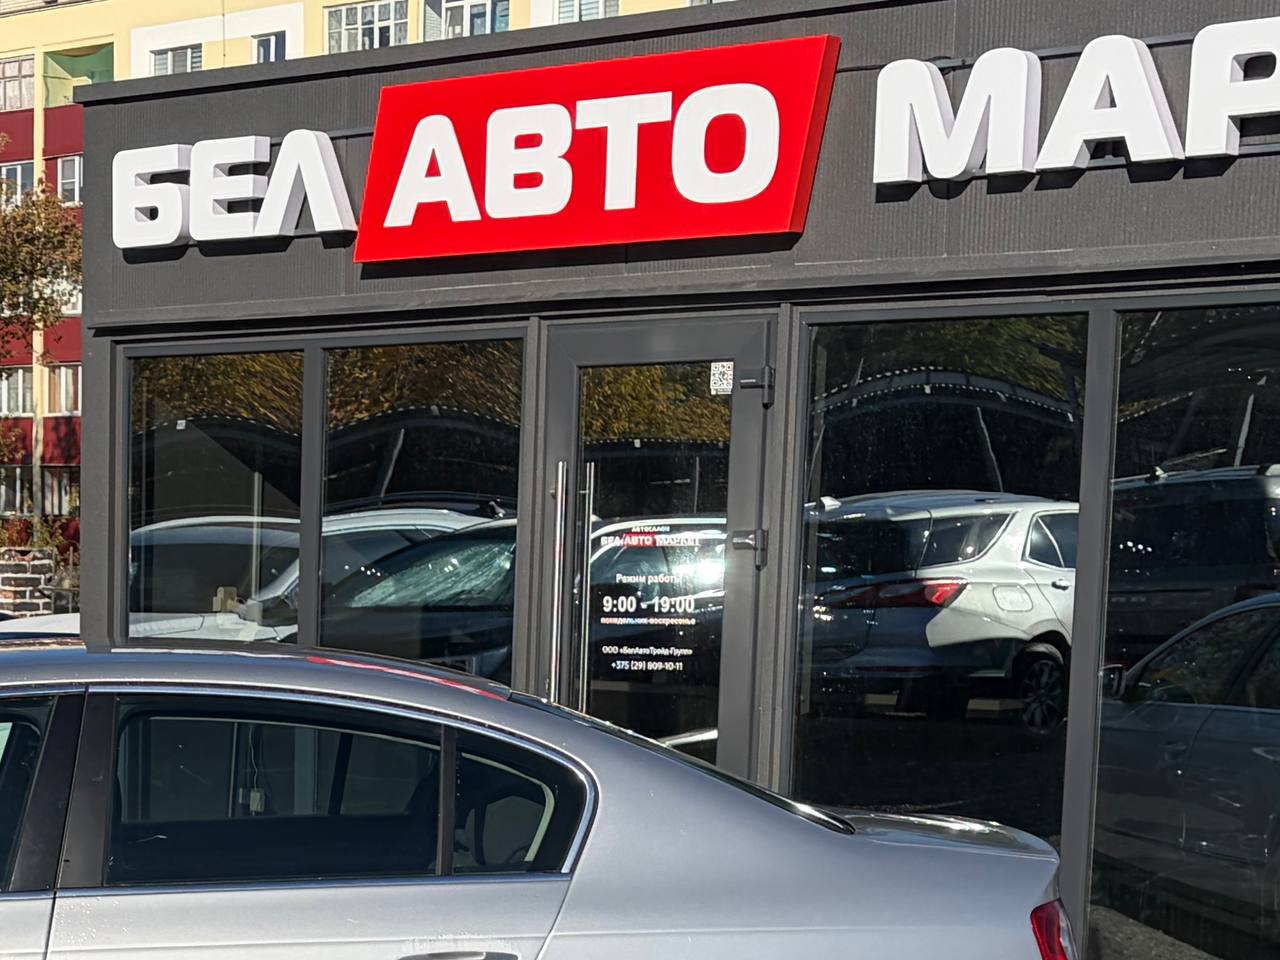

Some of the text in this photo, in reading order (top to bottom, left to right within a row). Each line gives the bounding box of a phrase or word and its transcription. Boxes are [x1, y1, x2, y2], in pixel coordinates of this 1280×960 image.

[112, 16, 1280, 248] БЕЛ АВТО МАР
[624, 535, 653, 545] АВТО
[616, 574, 646, 584] Режим
[603, 596, 637, 613] 9:00
[654, 596, 695, 613] 19:00
[602, 646, 619, 654] ООО
[611, 661, 629, 670] +375
[631, 661, 646, 670] (29)
